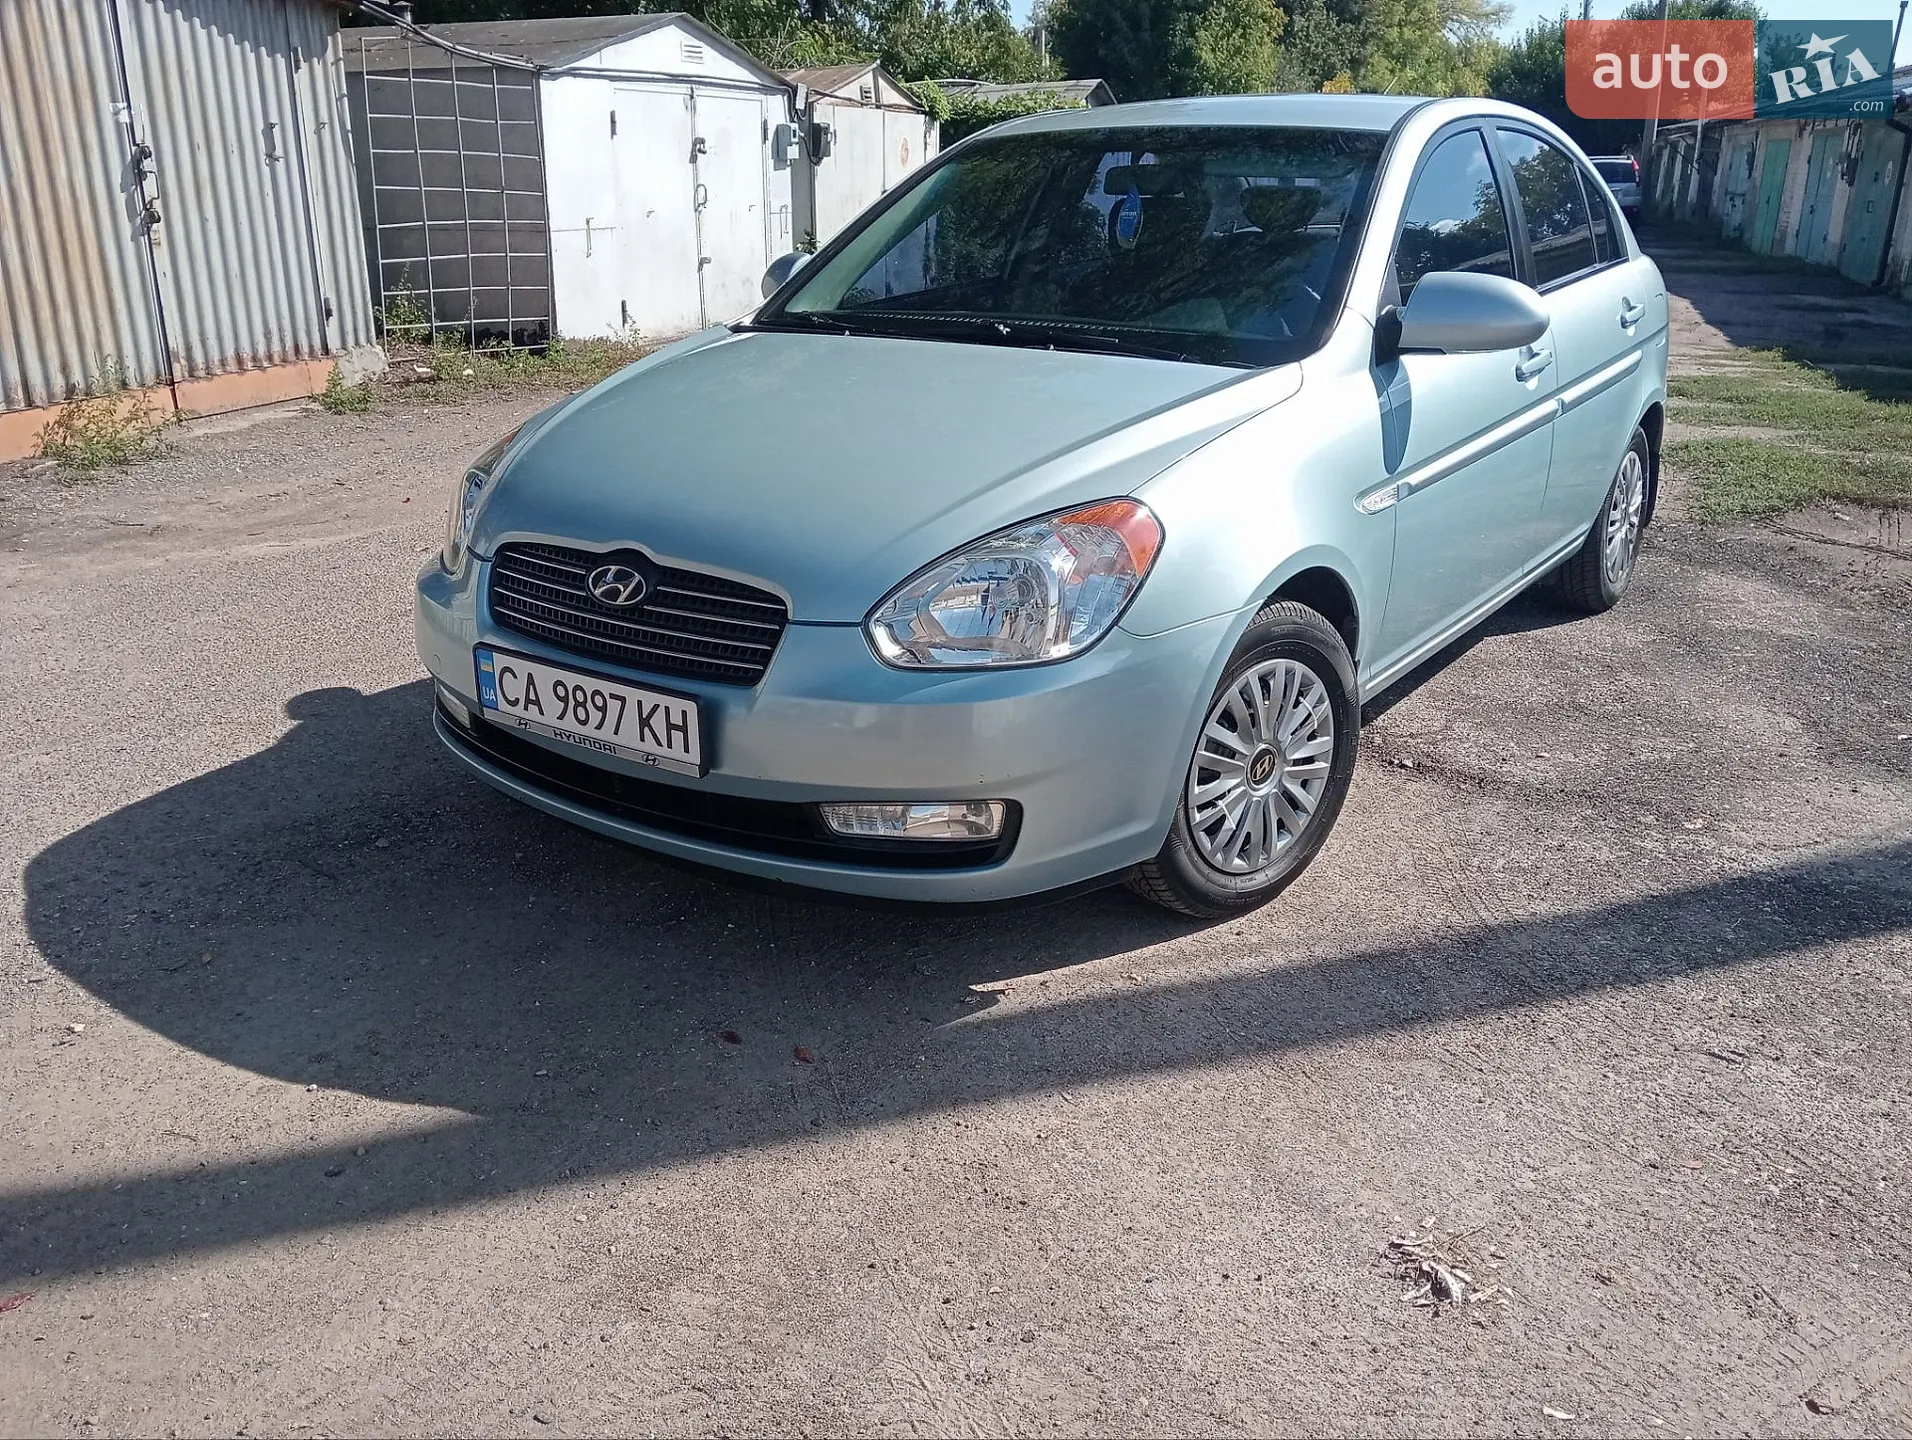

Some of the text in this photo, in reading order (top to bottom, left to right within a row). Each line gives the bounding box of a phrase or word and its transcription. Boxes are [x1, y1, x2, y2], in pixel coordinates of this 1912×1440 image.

[483, 687, 496, 702] UA
[499, 666, 690, 754] CA 9897 KH
[553, 729, 618, 755] HYUNDAI
